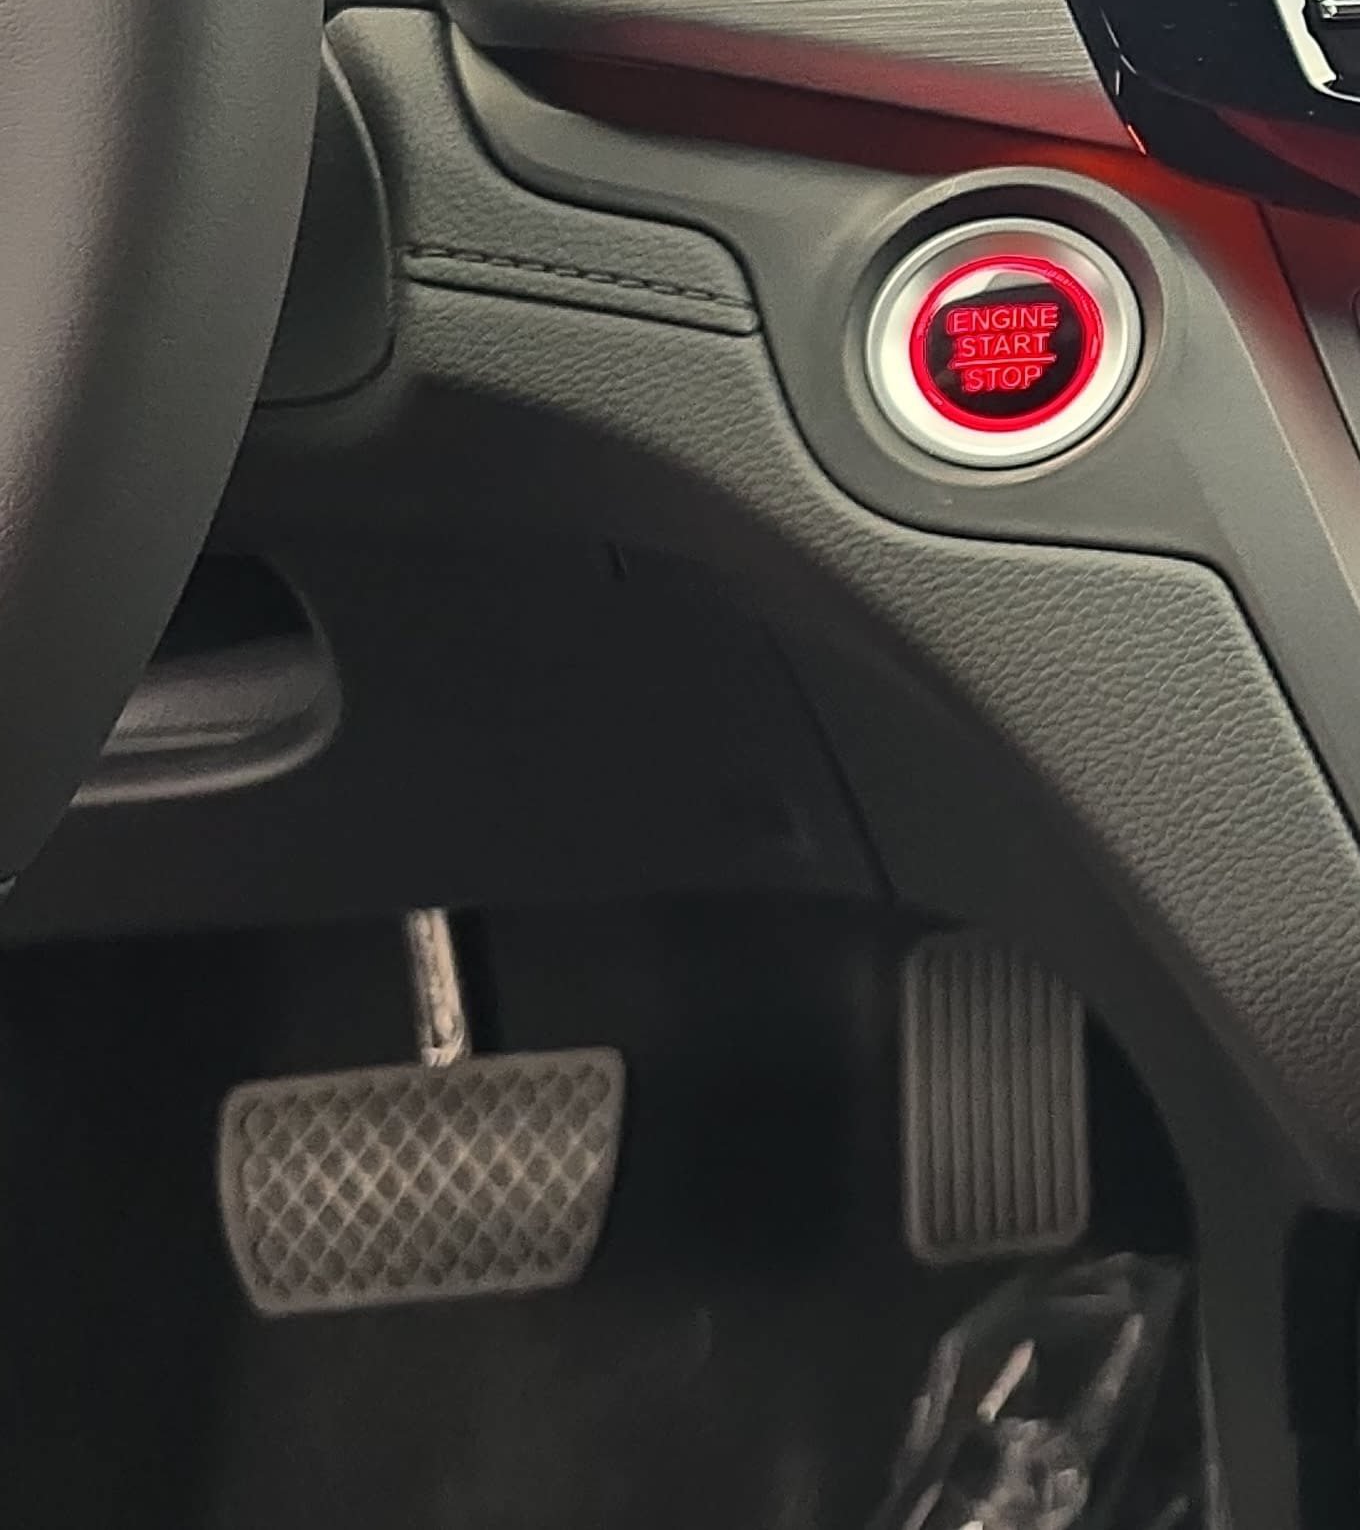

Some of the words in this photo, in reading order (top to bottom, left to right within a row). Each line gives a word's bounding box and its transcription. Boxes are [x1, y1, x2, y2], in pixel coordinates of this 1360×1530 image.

[951, 304, 1059, 334] ENGINE
[960, 332, 1050, 358] START
[965, 365, 1042, 392] STOP
